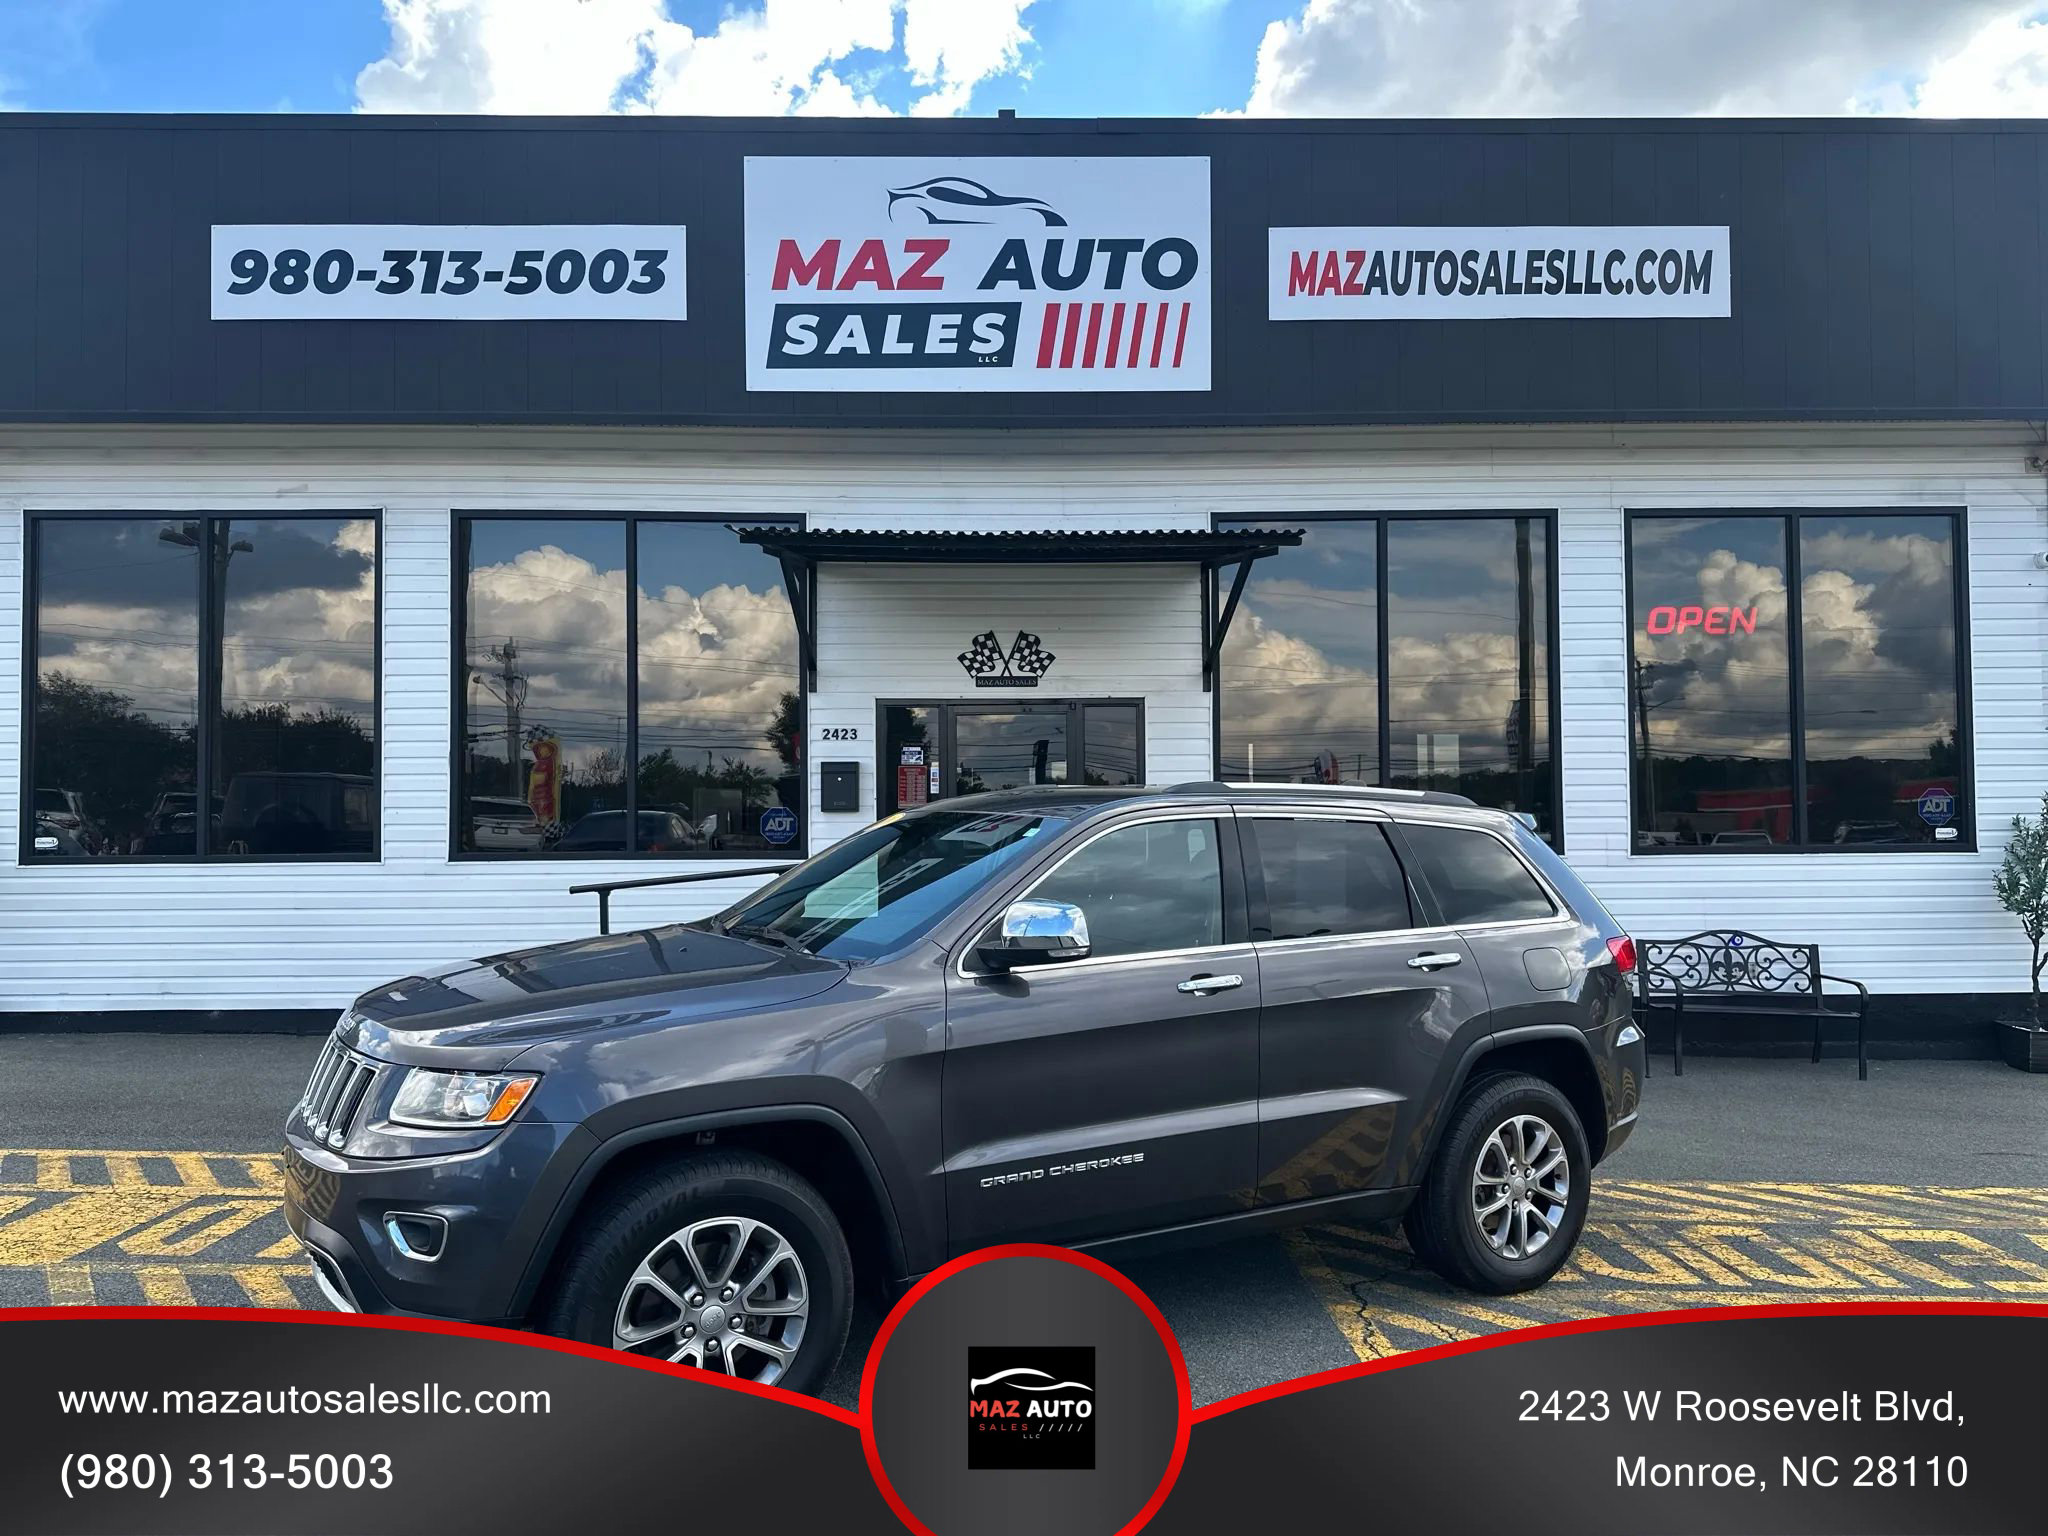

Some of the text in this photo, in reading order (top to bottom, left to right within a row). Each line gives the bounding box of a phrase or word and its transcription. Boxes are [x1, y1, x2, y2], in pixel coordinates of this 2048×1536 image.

[227, 249, 669, 295] 980-313-5003
[772, 237, 1199, 291] MAZ AUTO
[1288, 248, 1714, 297] MAZAUTOSALESLLC.COM
[781, 313, 1007, 355] SALES
[978, 355, 999, 363] LLC
[1647, 606, 1758, 635] OPEN
[822, 728, 858, 741] 2423
[1922, 798, 1951, 813] ADT
[764, 817, 794, 832] ADT
[980, 1152, 1144, 1188] GRAND CHEROKEE
